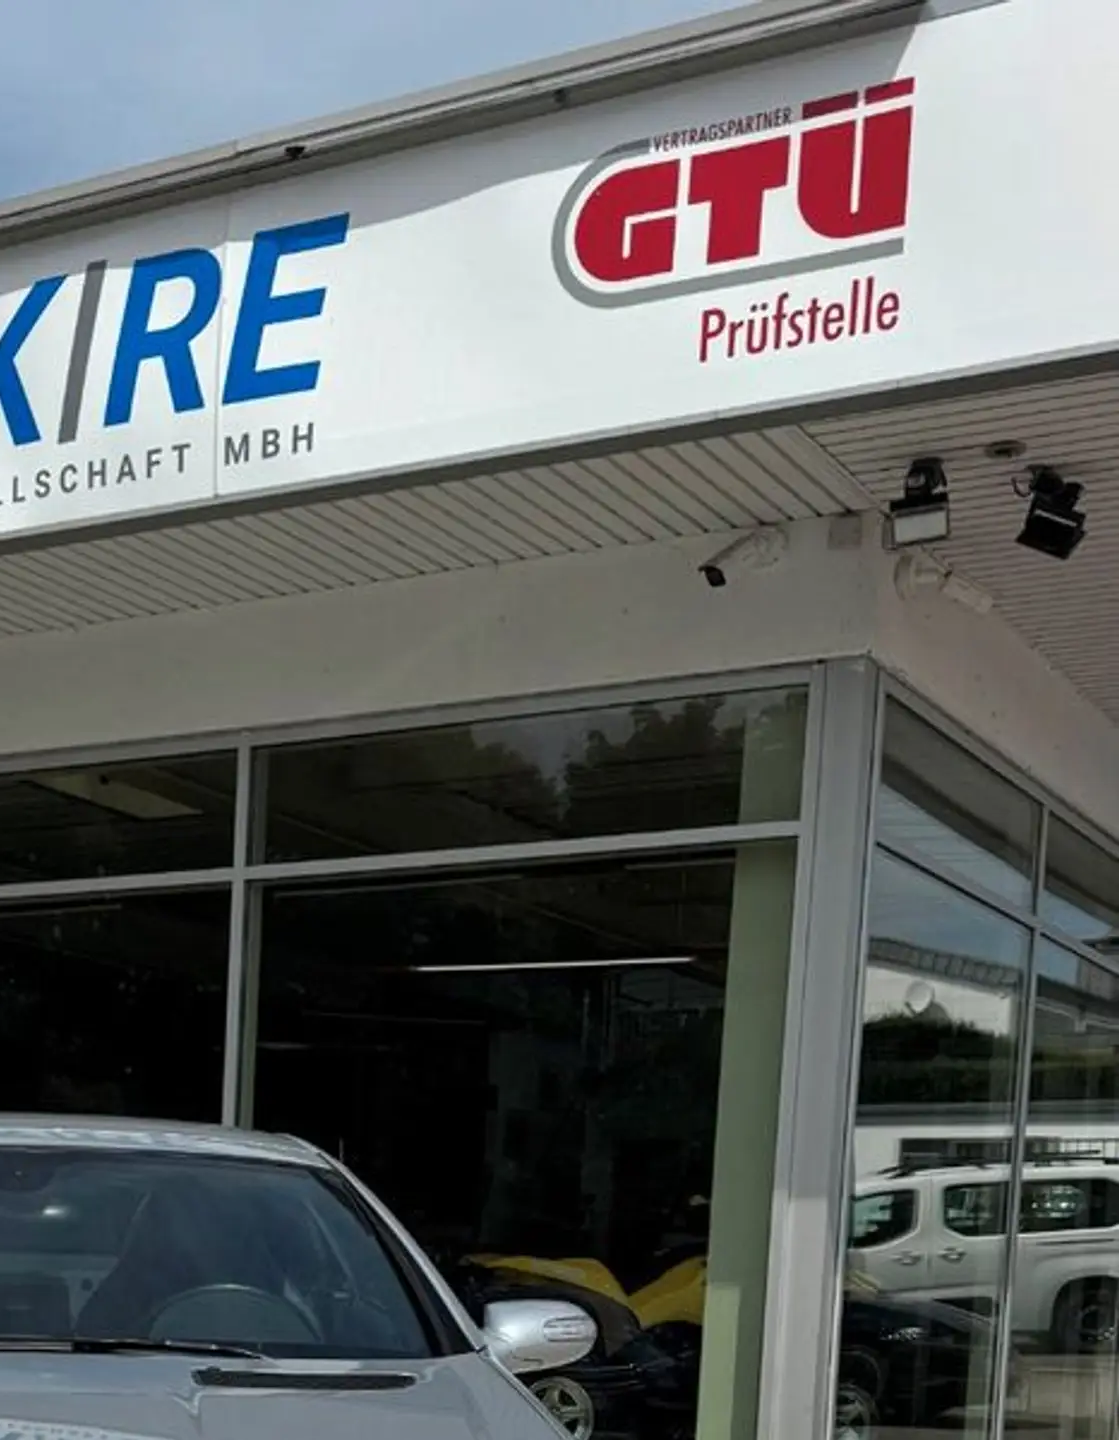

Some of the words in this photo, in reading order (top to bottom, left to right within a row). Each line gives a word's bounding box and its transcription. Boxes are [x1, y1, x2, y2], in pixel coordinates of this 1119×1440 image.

[653, 106, 793, 151] VERTRAGSPARTNER
[574, 77, 915, 282] GTÜ
[699, 276, 900, 363] Prüfstelle
[224, 422, 316, 467] MBH
